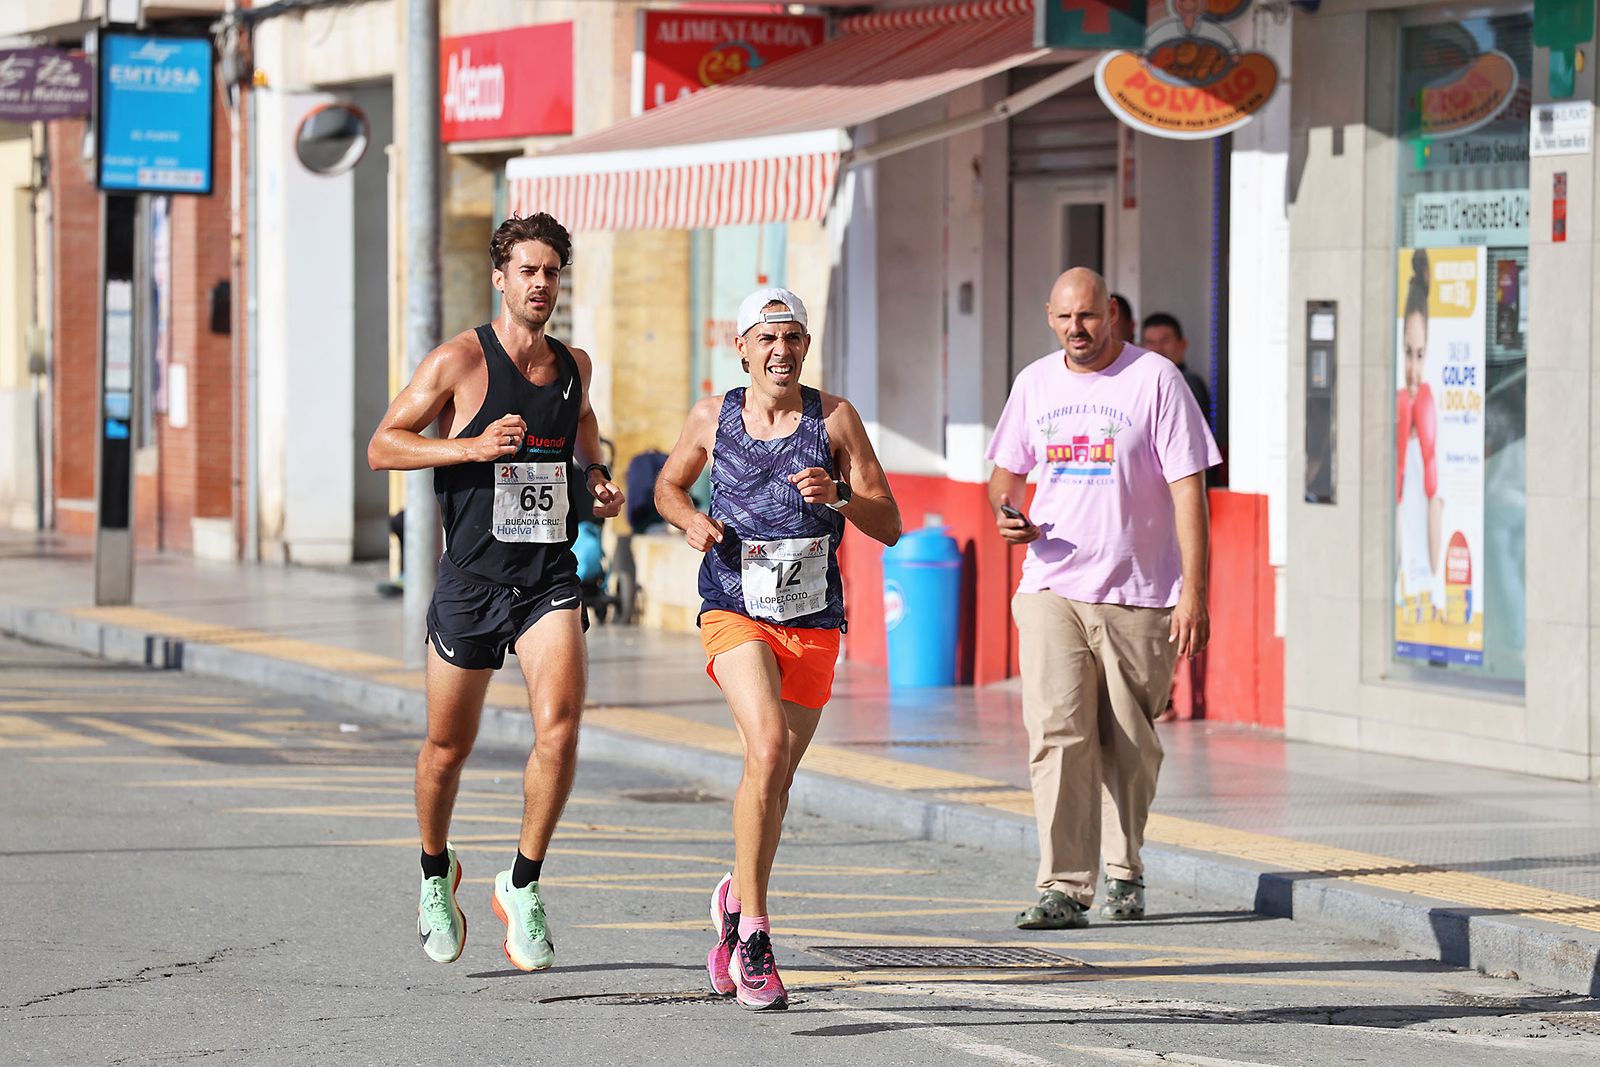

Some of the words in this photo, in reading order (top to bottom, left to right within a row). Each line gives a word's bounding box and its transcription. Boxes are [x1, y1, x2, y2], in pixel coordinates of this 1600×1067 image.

[708, 52, 741, 72] 24
[109, 64, 201, 86] EMTUSA
[1125, 67, 1256, 112] POLVILLO
[1443, 366, 1476, 386] GOLPE
[520, 485, 554, 511] 65
[497, 525, 532, 535] Huelva
[771, 561, 802, 588] 12
[760, 594, 785, 604] LOPEZ
[785, 591, 808, 601] COTO
